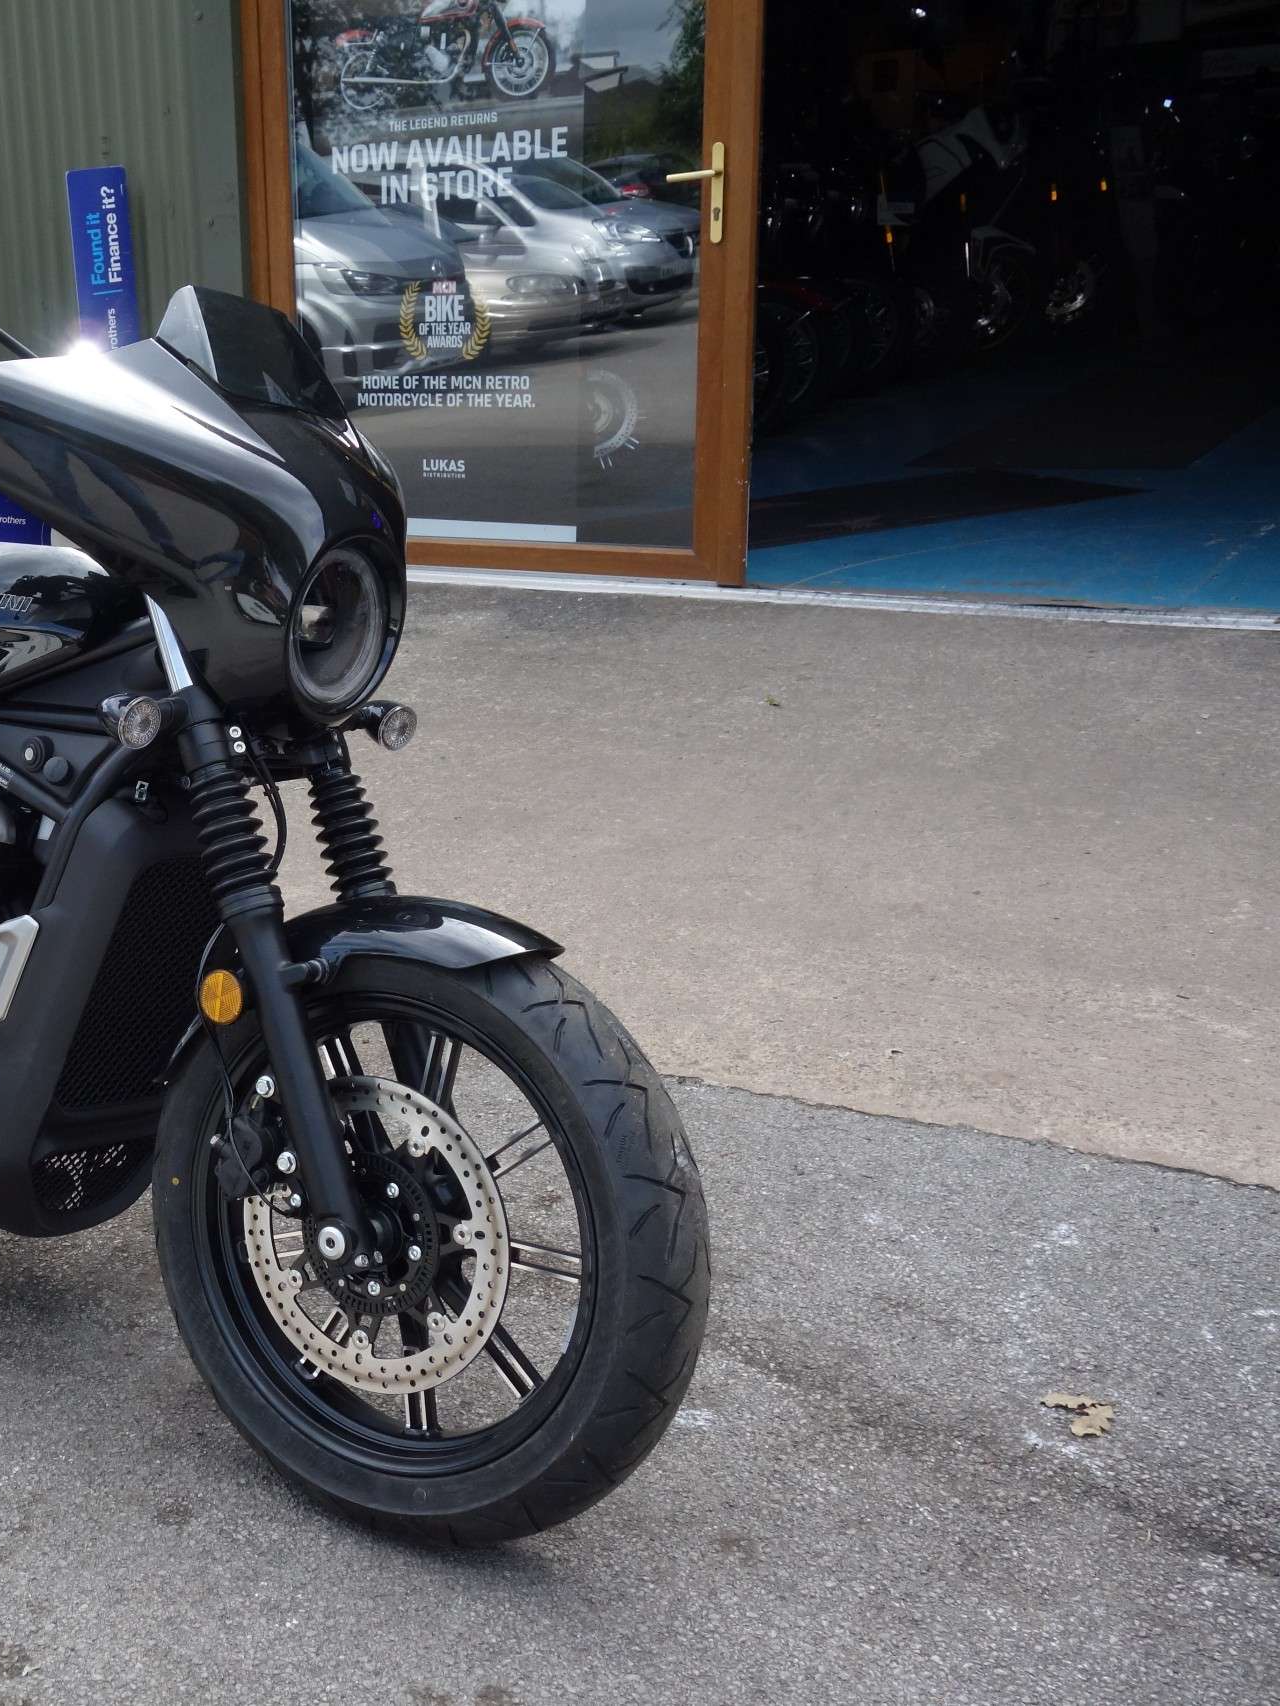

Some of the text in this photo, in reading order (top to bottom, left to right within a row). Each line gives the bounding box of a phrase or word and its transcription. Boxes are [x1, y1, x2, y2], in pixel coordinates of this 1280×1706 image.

[389, 112, 498, 132] THE LEGEND RETURNS
[331, 126, 568, 174] NOW AVAILABLE
[381, 167, 513, 205] IN-STORE
[100, 185, 123, 284] Finance it?
[86, 212, 106, 286] Found it
[432, 281, 456, 294] MCN
[424, 294, 465, 322] BIKE
[107, 308, 118, 350] rothers
[419, 322, 471, 335] OF THE YEAR
[426, 335, 463, 348] AWARDS
[362, 375, 530, 390] HOME OF THE MCN RETRO
[357, 392, 536, 408] MOTORCYCLE OF THE YEAR.
[423, 458, 466, 472] LUKAS
